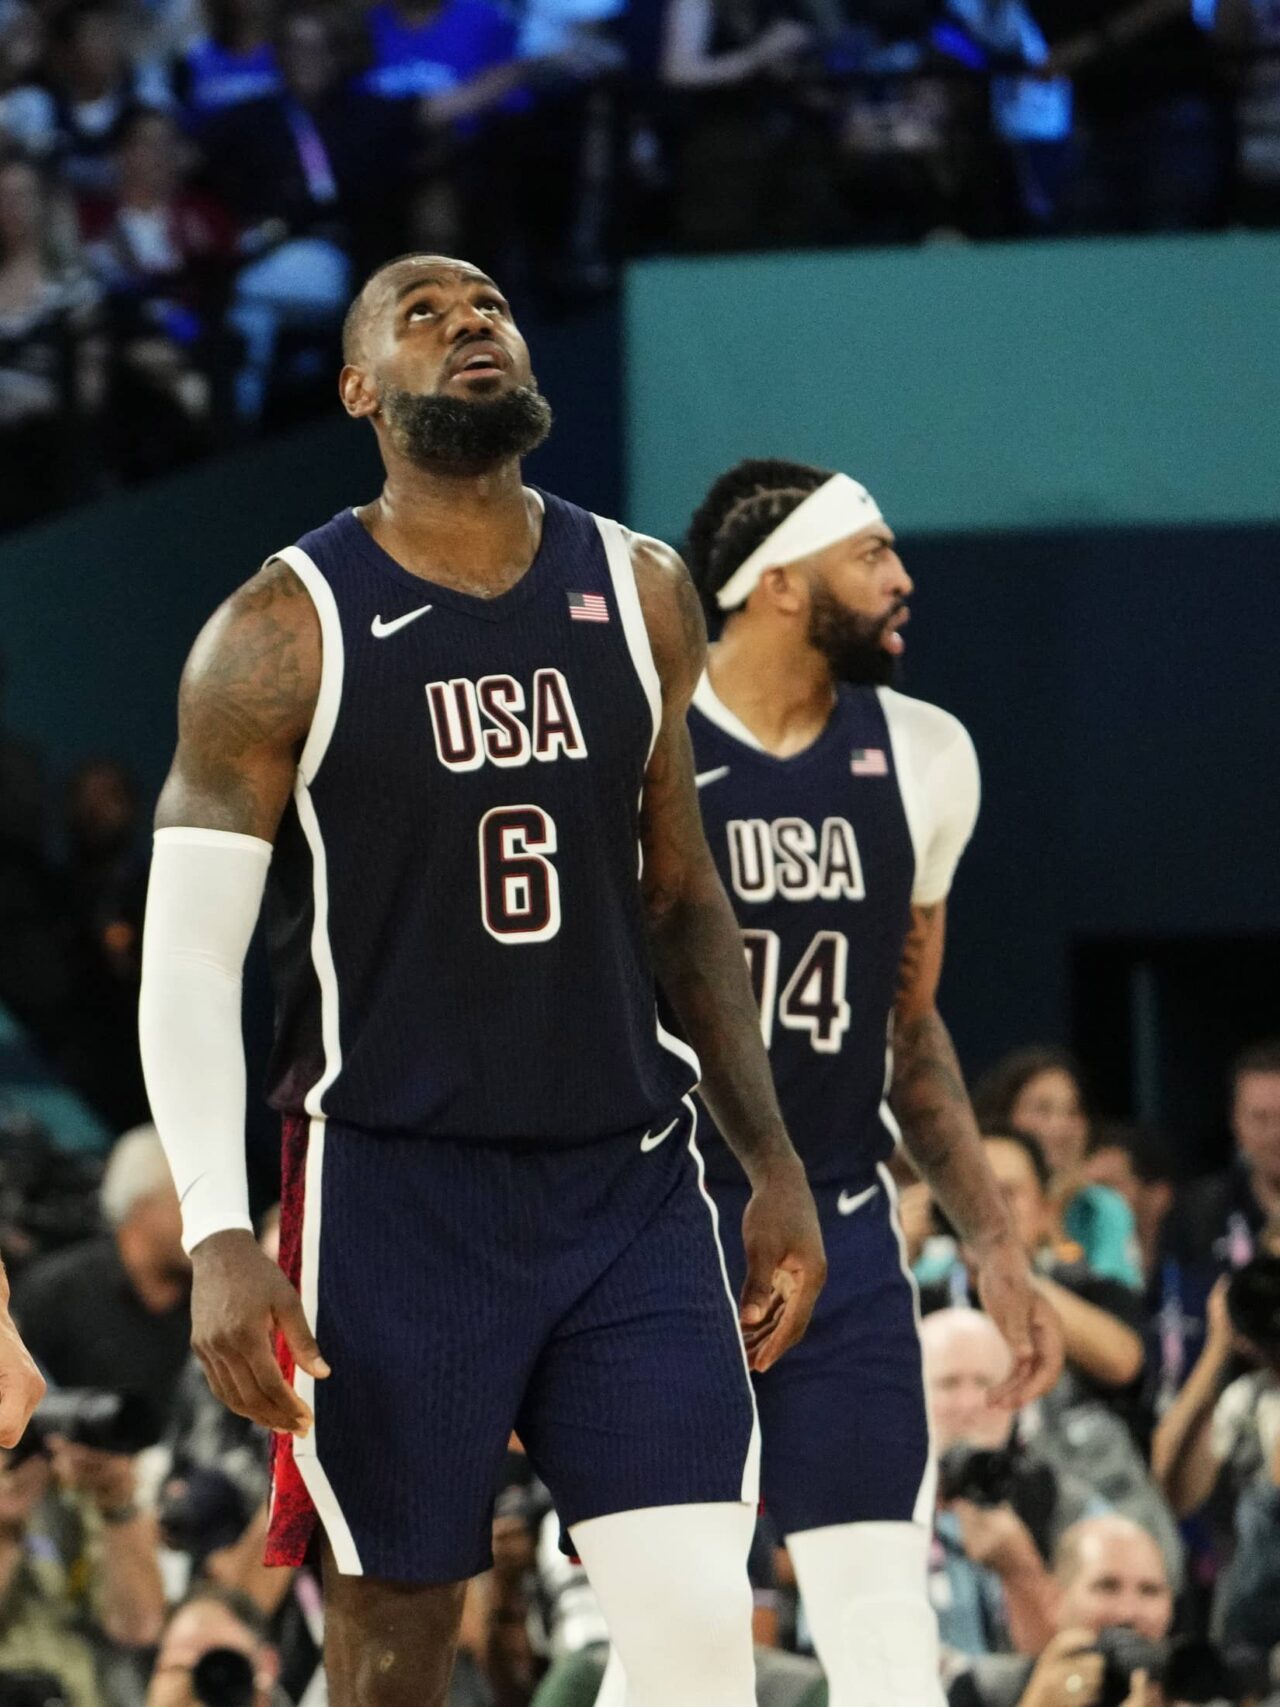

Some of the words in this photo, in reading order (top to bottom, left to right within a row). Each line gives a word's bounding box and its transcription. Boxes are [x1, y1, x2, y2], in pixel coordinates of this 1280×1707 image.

[425, 668, 587, 772] USA
[479, 805, 561, 943] 6
[727, 818, 866, 901] USA
